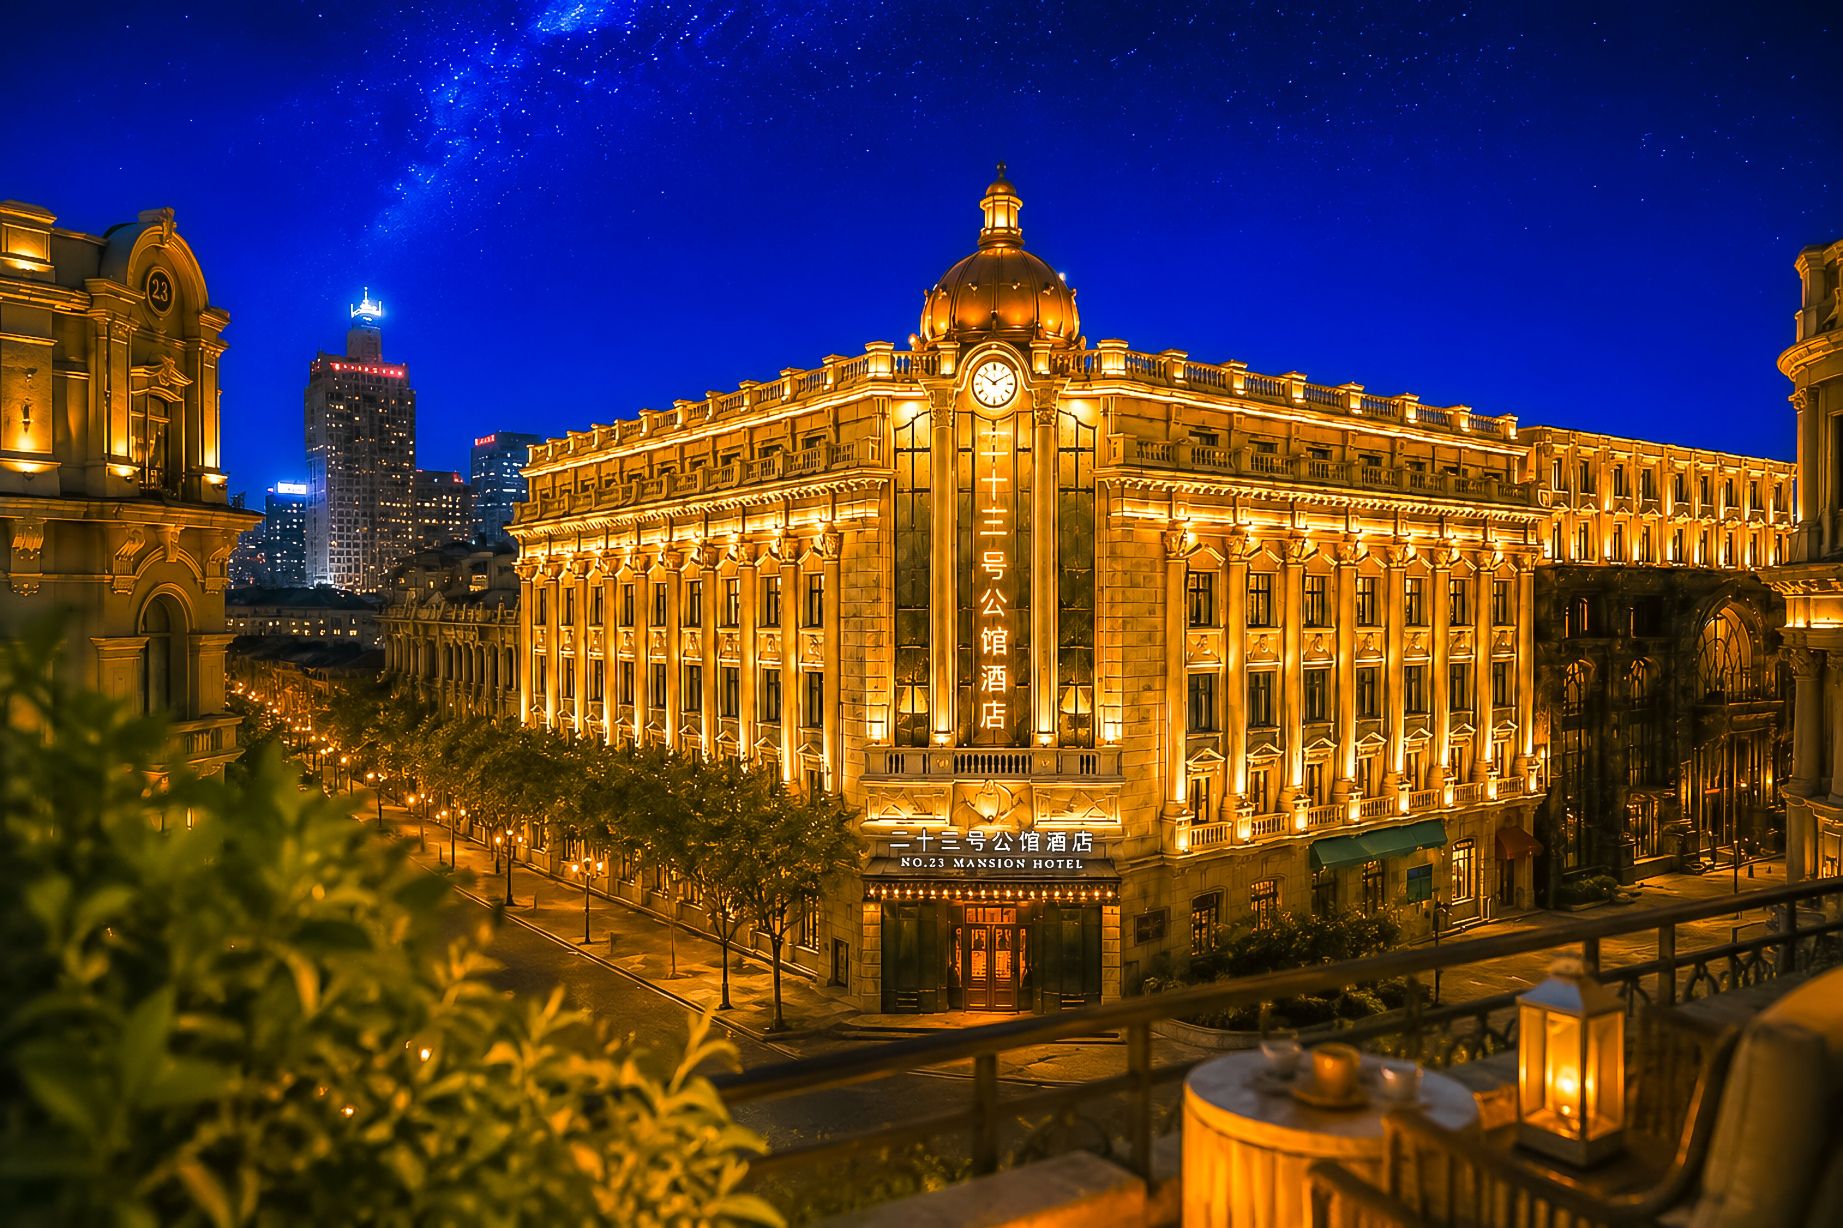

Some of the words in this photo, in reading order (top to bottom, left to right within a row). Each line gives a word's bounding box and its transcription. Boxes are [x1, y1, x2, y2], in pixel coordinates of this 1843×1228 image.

[152, 278, 168, 302] 23
[979, 431, 1009, 730] 二十三号公馆酒店
[889, 827, 1093, 853] 二十三号公馆酒店
[900, 857, 945, 869] NO.23
[953, 858, 1026, 869] MANSION
[1032, 858, 1083, 870] HOTEL
